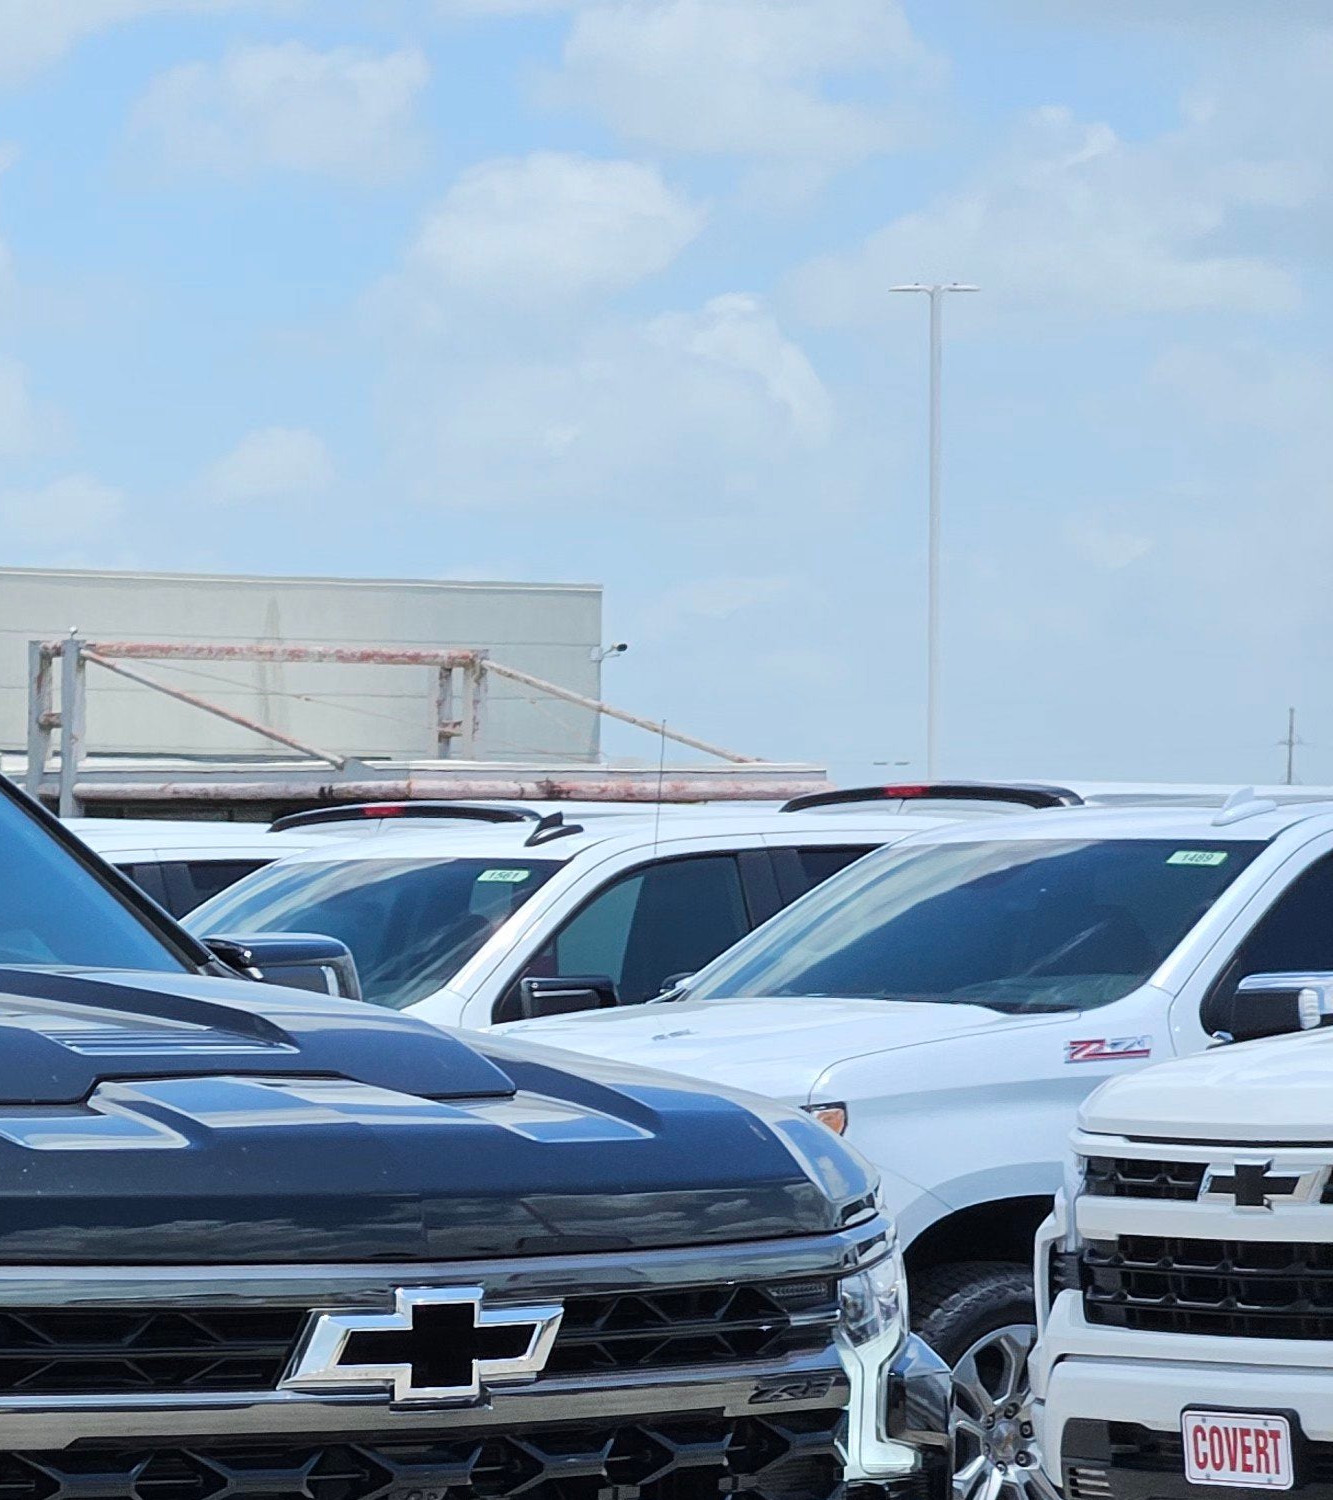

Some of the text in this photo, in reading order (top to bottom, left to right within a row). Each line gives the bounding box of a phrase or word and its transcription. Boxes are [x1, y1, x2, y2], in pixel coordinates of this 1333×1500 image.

[1063, 1035, 1152, 1063] Z71
[747, 1376, 835, 1404] ZR2
[1193, 1424, 1281, 1475] COVERT
